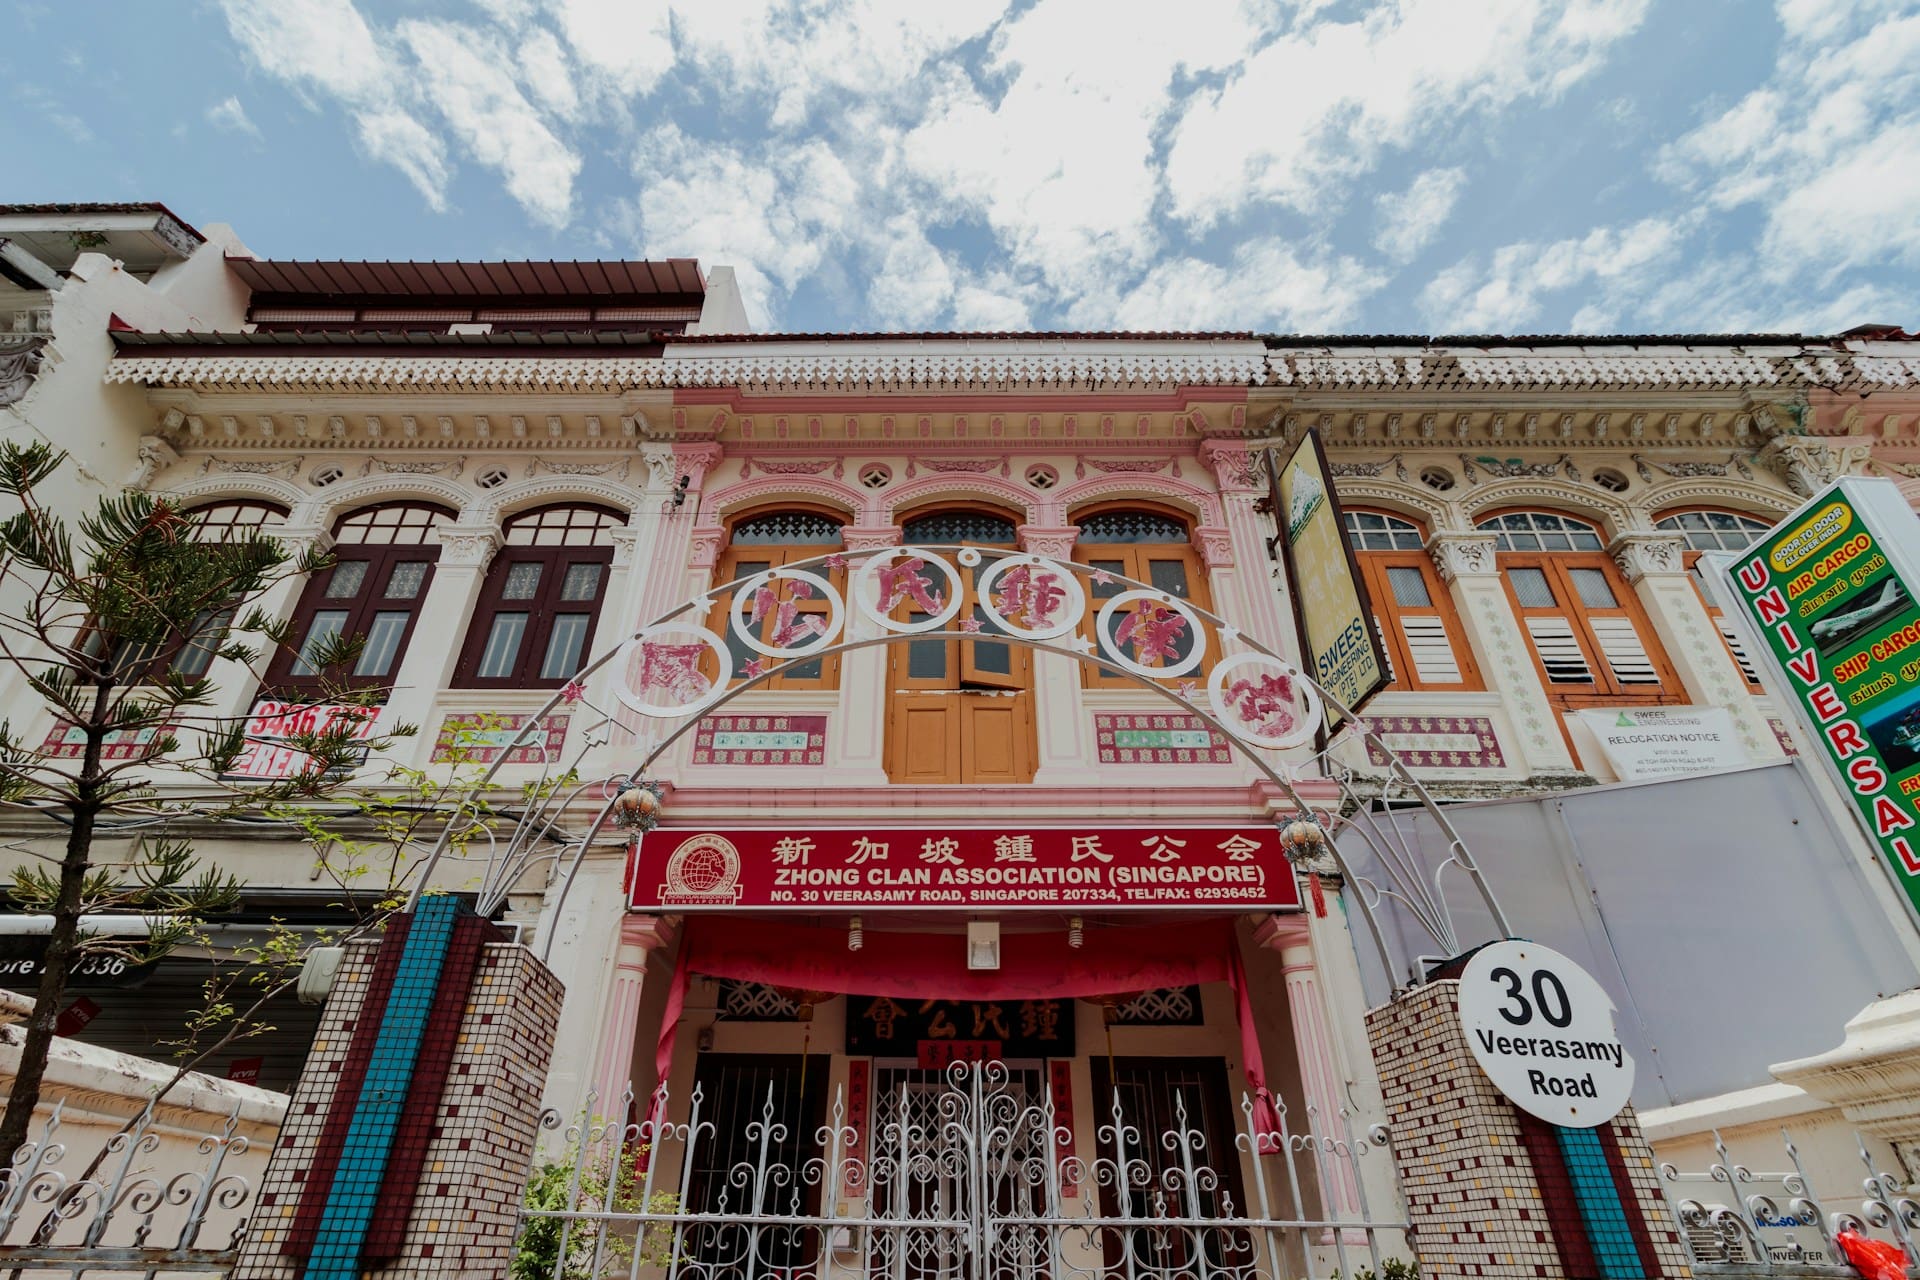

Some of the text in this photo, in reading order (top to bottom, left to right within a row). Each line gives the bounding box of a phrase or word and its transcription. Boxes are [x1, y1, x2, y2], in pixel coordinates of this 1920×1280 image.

[1774, 507, 1844, 562] DOOR TO DOOR
[1785, 523, 1842, 568] ALL OVER INDIA
[1788, 534, 1870, 599] AIR CARGO
[1319, 617, 1364, 678] SWEES
[1322, 639, 1370, 693] ENGINEERING
[1834, 652, 1869, 683] SHIP
[1338, 670, 1358, 697] (PTE)
[1634, 711, 1666, 719] SWEES
[1637, 718, 1701, 727] ENGINEERING
[1739, 559, 1920, 873] UNIVERSAL
[1608, 733, 1721, 745] RELOCATION NOTICE
[1900, 775, 1920, 795] FR
[771, 834, 1261, 865] 新加坡鍾氏公会
[774, 865, 1265, 886] ZHONG CLAN ASSOCIATION (SINGAPORE)
[771, 886, 1267, 903] NO. 30 VEERASAMY ROAD, SINGAPORE 207334, TEL/FAX: 62936452
[1490, 967, 1572, 1028] 30
[1476, 1028, 1623, 1068] Veerasamy
[1528, 1069, 1598, 1098] Road
[1768, 1251, 1823, 1261] INVETER
